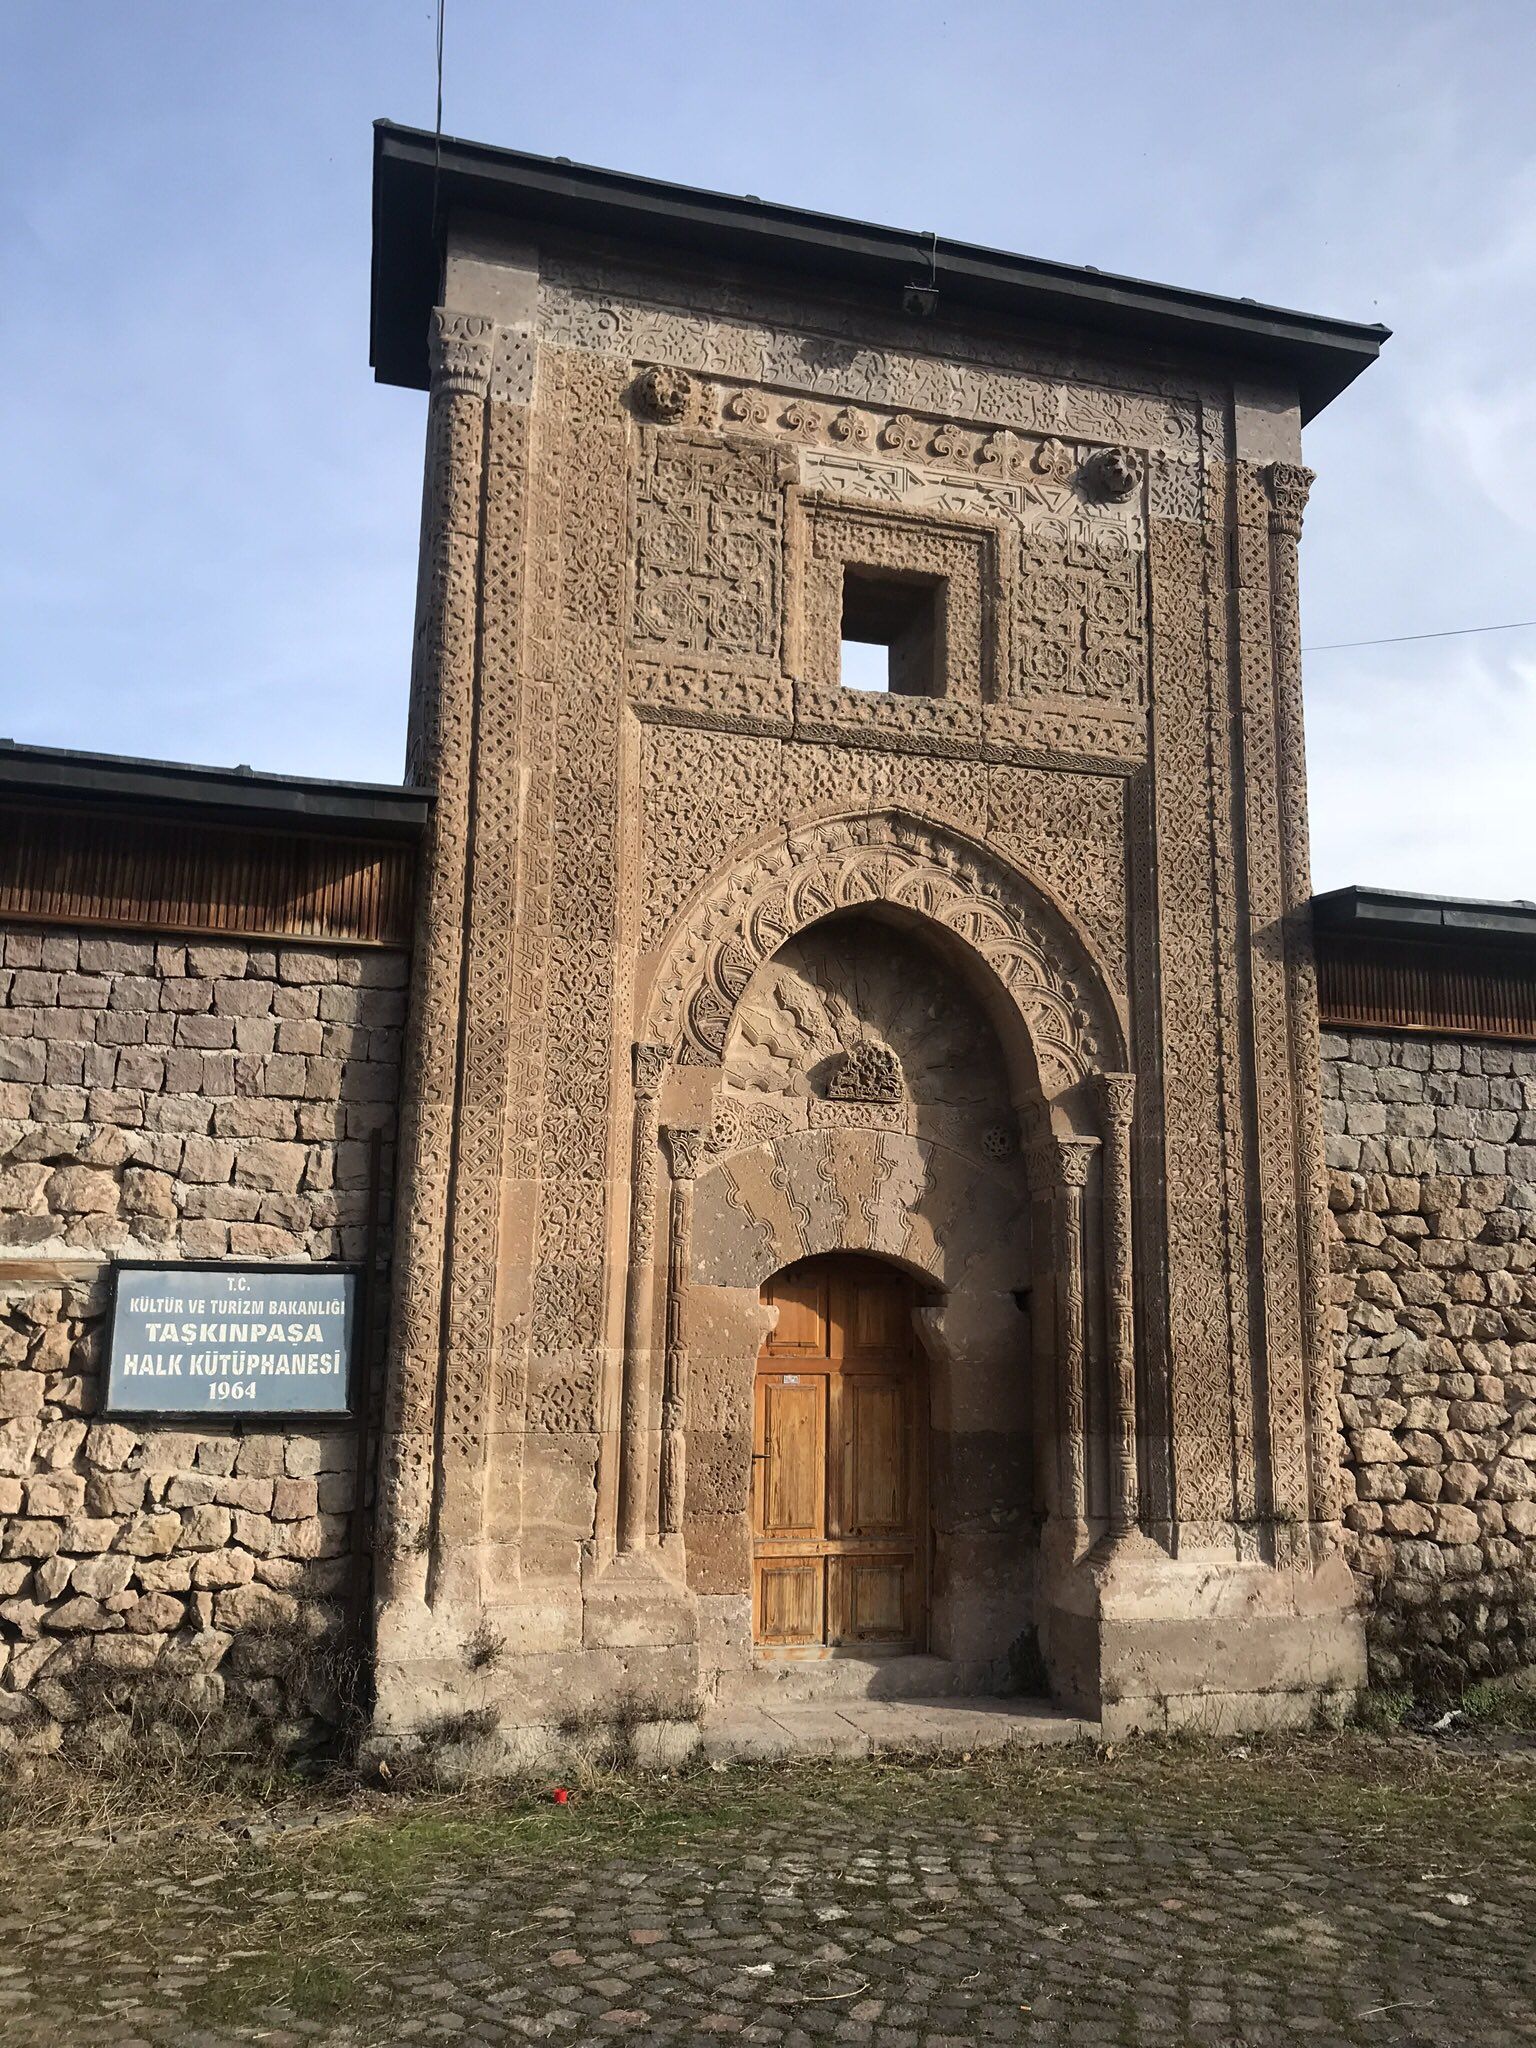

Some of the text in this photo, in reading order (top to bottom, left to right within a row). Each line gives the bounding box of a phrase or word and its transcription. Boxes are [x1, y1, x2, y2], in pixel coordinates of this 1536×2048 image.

[227, 1277, 250, 1292] T.C.
[130, 1296, 345, 1315] KÜLTÜR VE TURİZM BAKANLIĞI
[145, 1323, 324, 1346] TAŞKINPAŞA
[123, 1350, 340, 1376] HALK KÜTÜPHANESİ
[208, 1381, 257, 1400] 1964
